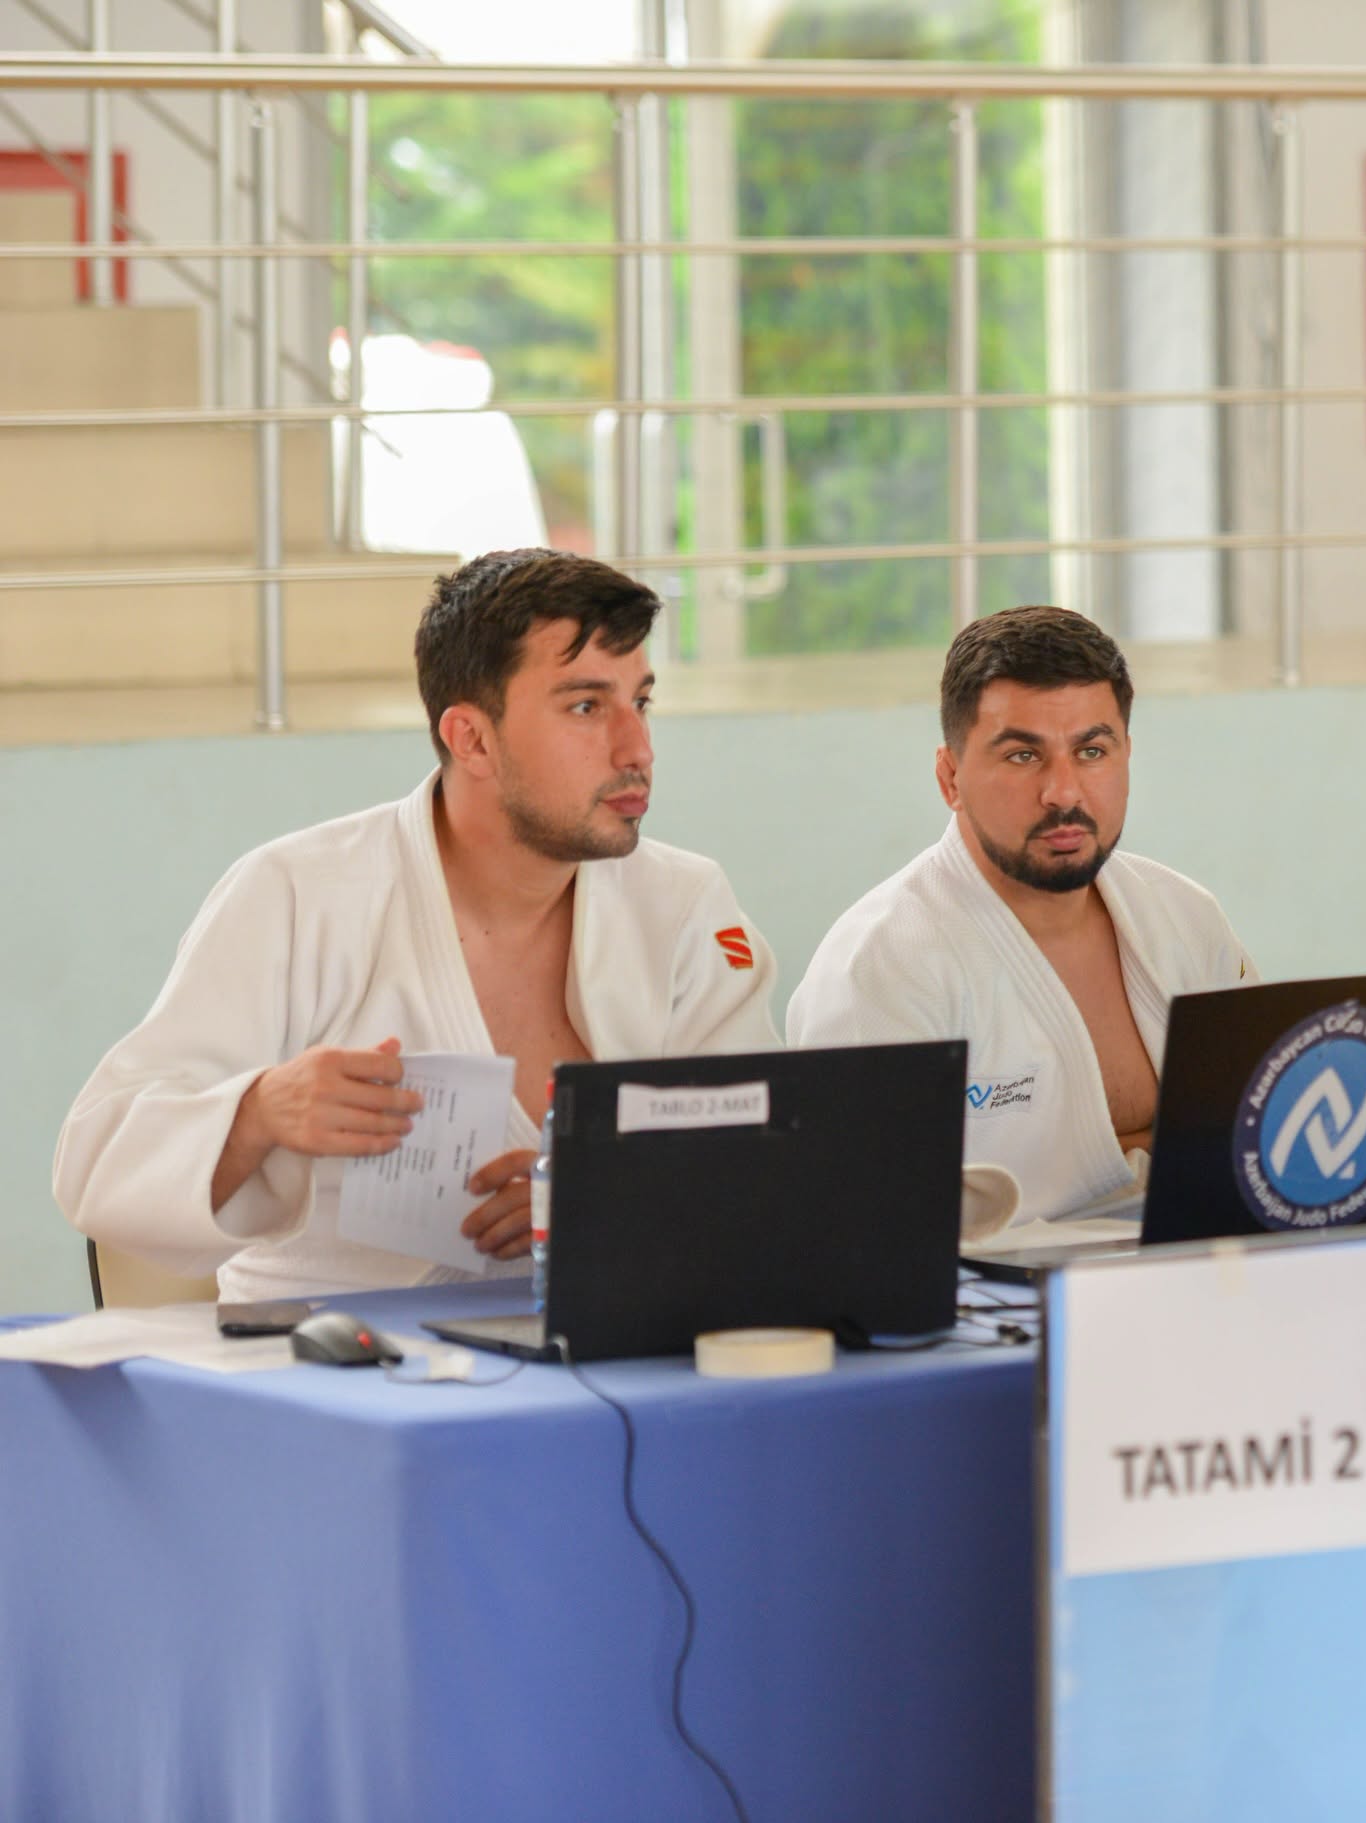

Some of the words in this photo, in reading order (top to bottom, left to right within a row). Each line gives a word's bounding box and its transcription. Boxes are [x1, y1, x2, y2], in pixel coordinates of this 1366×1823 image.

[651, 1099, 701, 1116] TABLO
[1291, 1208, 1328, 1228] Judo
[1112, 1414, 1312, 1501] TATAMİ
[1331, 1425, 1362, 1481] 2
